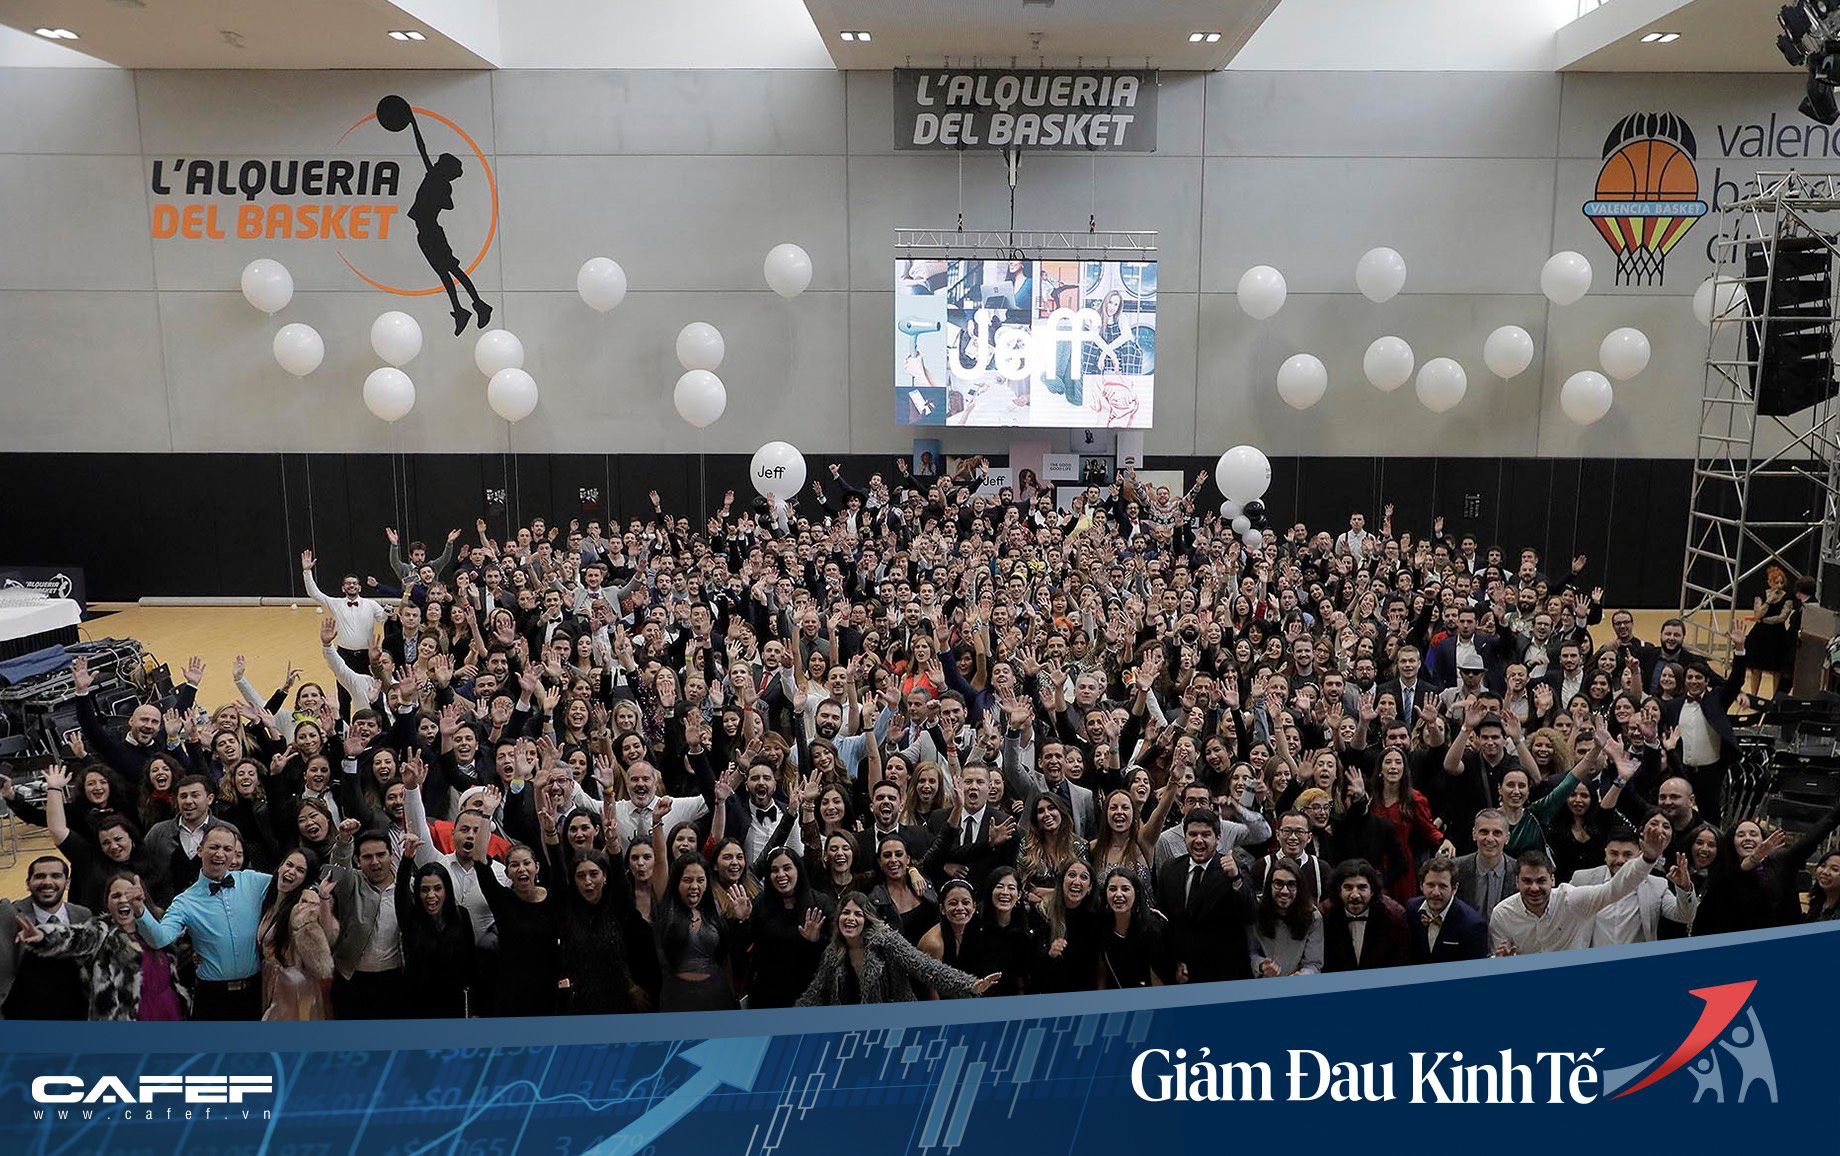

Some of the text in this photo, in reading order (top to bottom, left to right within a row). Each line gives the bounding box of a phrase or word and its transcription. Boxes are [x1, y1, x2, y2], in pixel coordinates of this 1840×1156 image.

[916, 75, 1140, 111] L'ALQUERIA
[912, 113, 1135, 147] DEL BASKET
[151, 159, 400, 201] L'ALQUERIA
[152, 203, 398, 240] DEL BASKET
[1591, 203, 1700, 215] VALENCIA BASKET
[949, 308, 1102, 381] Jeff
[757, 465, 786, 479] Jeff
[983, 475, 1006, 487] Jeff
